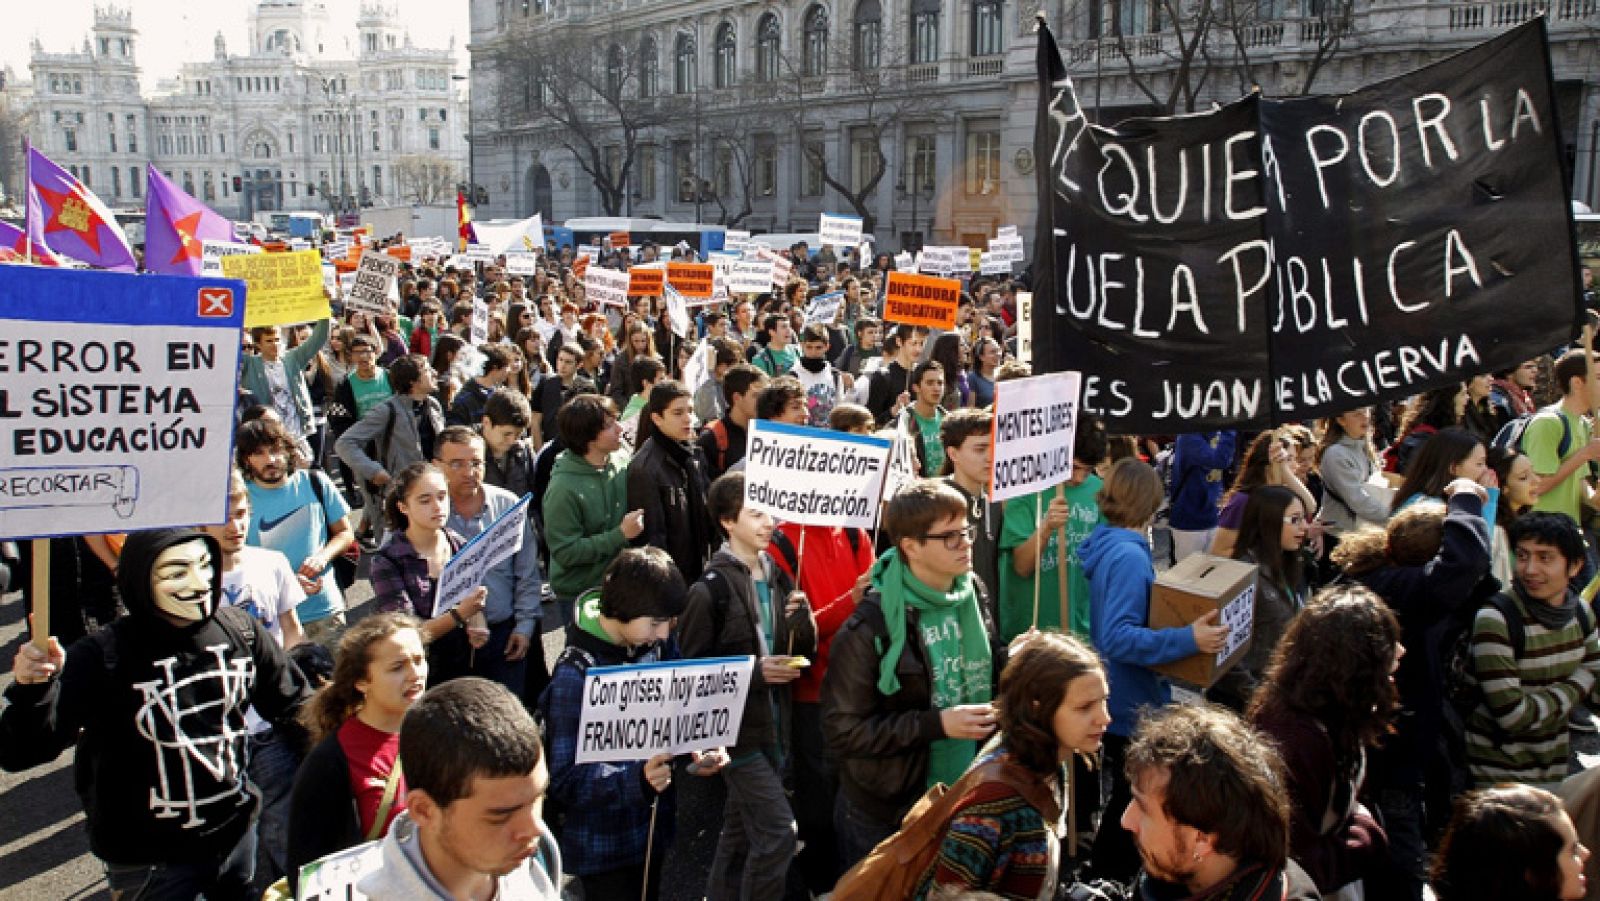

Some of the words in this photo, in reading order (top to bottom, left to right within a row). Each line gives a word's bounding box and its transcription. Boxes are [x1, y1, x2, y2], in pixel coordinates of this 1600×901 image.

[1305, 93, 1459, 208] POR
[1480, 88, 1542, 151] LA
[888, 300, 952, 320] "EDUCATIVA"
[889, 281, 957, 303] DICTADURA
[167, 342, 215, 371] EN
[1152, 379, 1261, 418] JUAN
[1275, 376, 1294, 411] E
[1302, 369, 1332, 405] LA
[1337, 334, 1480, 397] CIERVA
[996, 408, 1042, 442] MENTES
[995, 451, 1048, 490] SOCIEDAD
[748, 481, 871, 518] educastración.
[589, 675, 617, 707] Con
[619, 671, 665, 711] grises,
[669, 669, 695, 707] hoy
[696, 665, 738, 698] azules,
[583, 719, 648, 751] FRANCO
[650, 717, 672, 748] HA
[676, 707, 730, 745] VUELTO.
